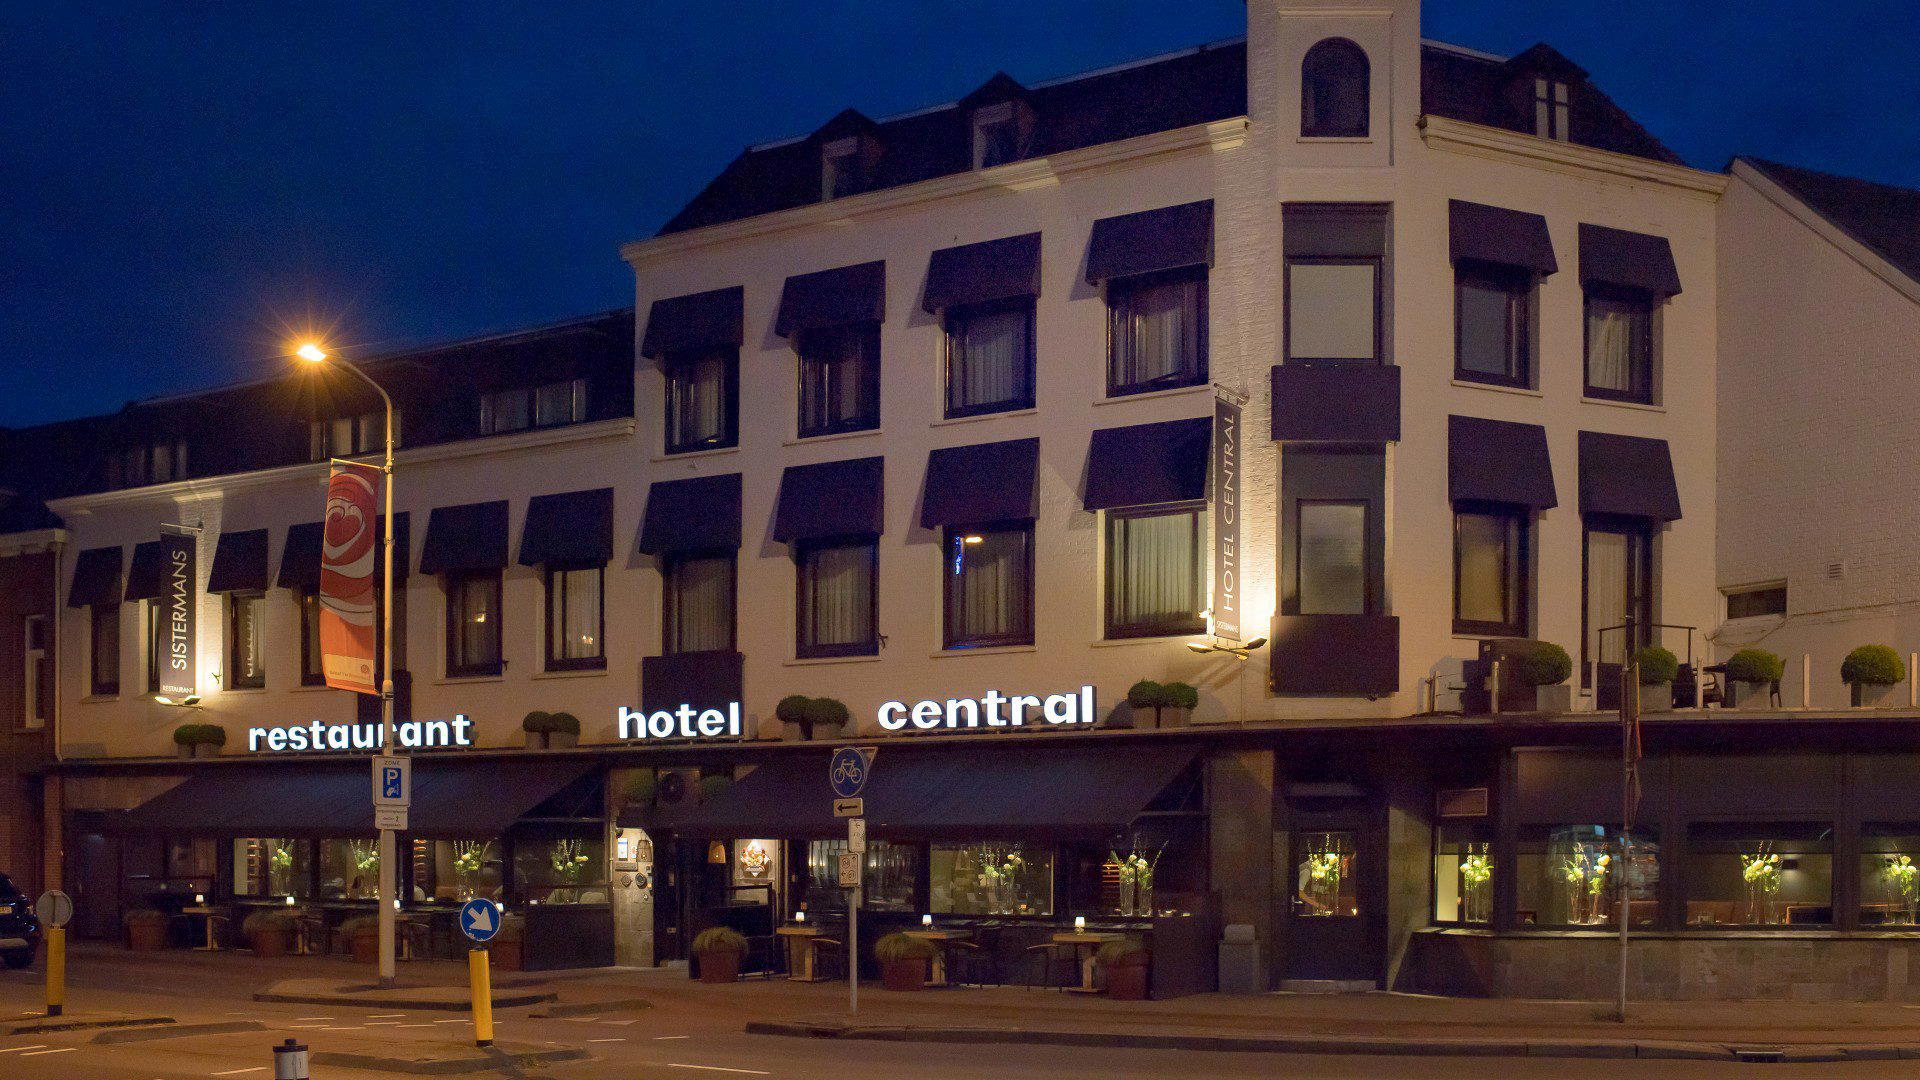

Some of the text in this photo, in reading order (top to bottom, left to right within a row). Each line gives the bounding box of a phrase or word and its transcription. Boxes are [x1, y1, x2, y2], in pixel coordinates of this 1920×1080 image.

[1224, 415, 1234, 525] CENTRAL
[1224, 534, 1234, 612] HOTEL
[172, 550, 187, 671] SISTERMANS
[618, 702, 740, 738] hotel
[877, 685, 1093, 730] central
[249, 714, 471, 751] restaurant
[387, 768, 398, 785] P
